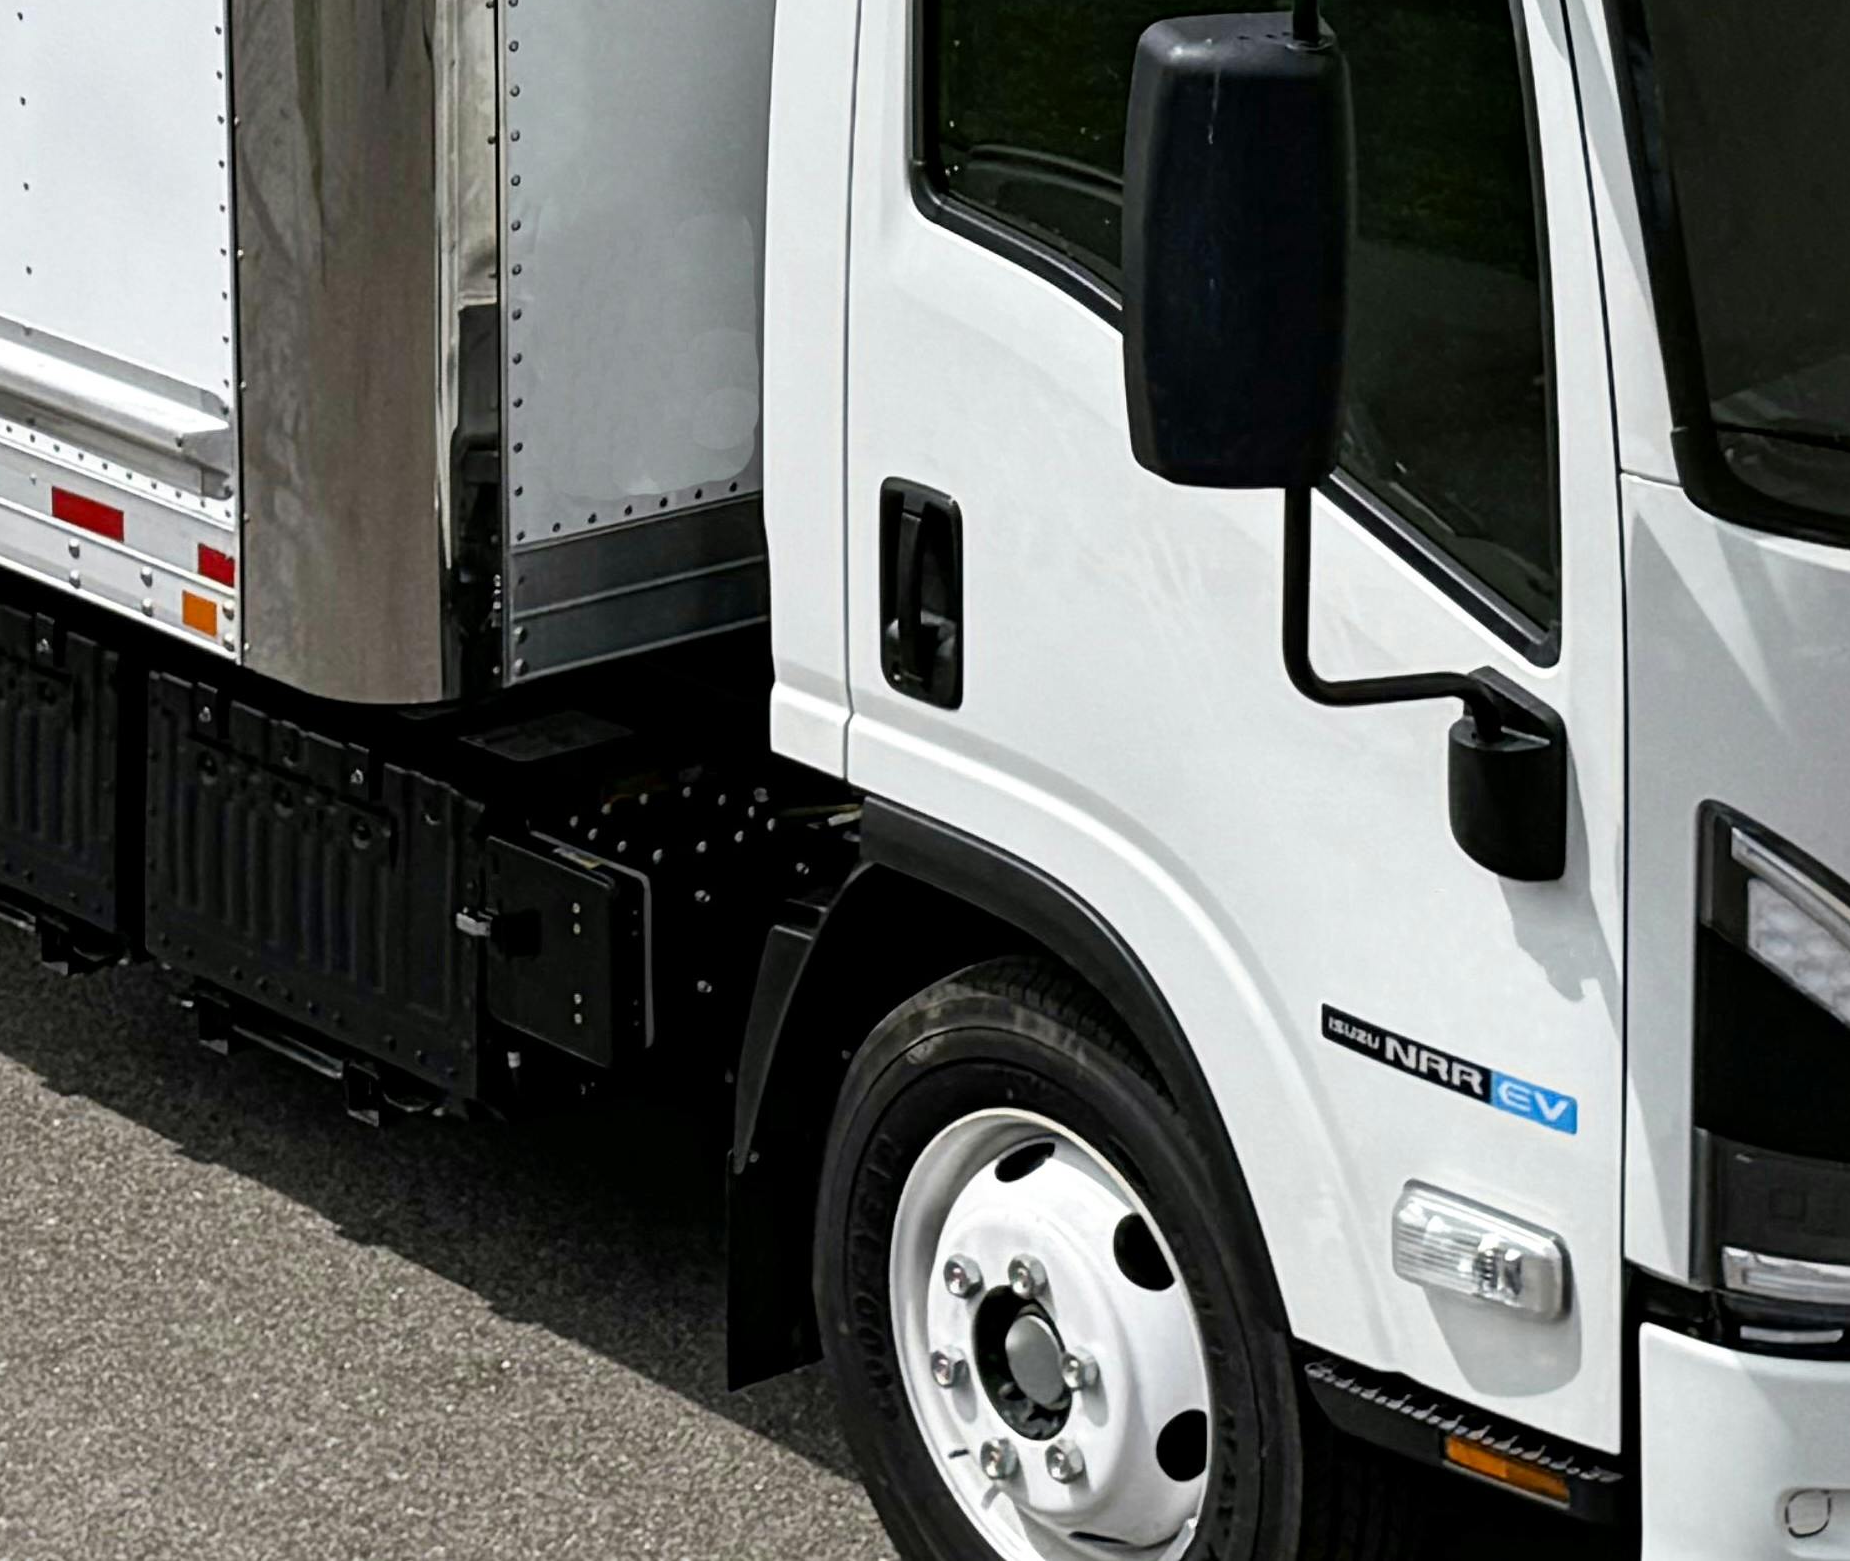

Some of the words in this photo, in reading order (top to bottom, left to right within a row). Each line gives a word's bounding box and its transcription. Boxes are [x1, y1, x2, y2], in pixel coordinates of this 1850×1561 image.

[1327, 1015, 1381, 1050] ISUZU
[1384, 1035, 1485, 1096] NRR
[1497, 1080, 1569, 1122] EV
